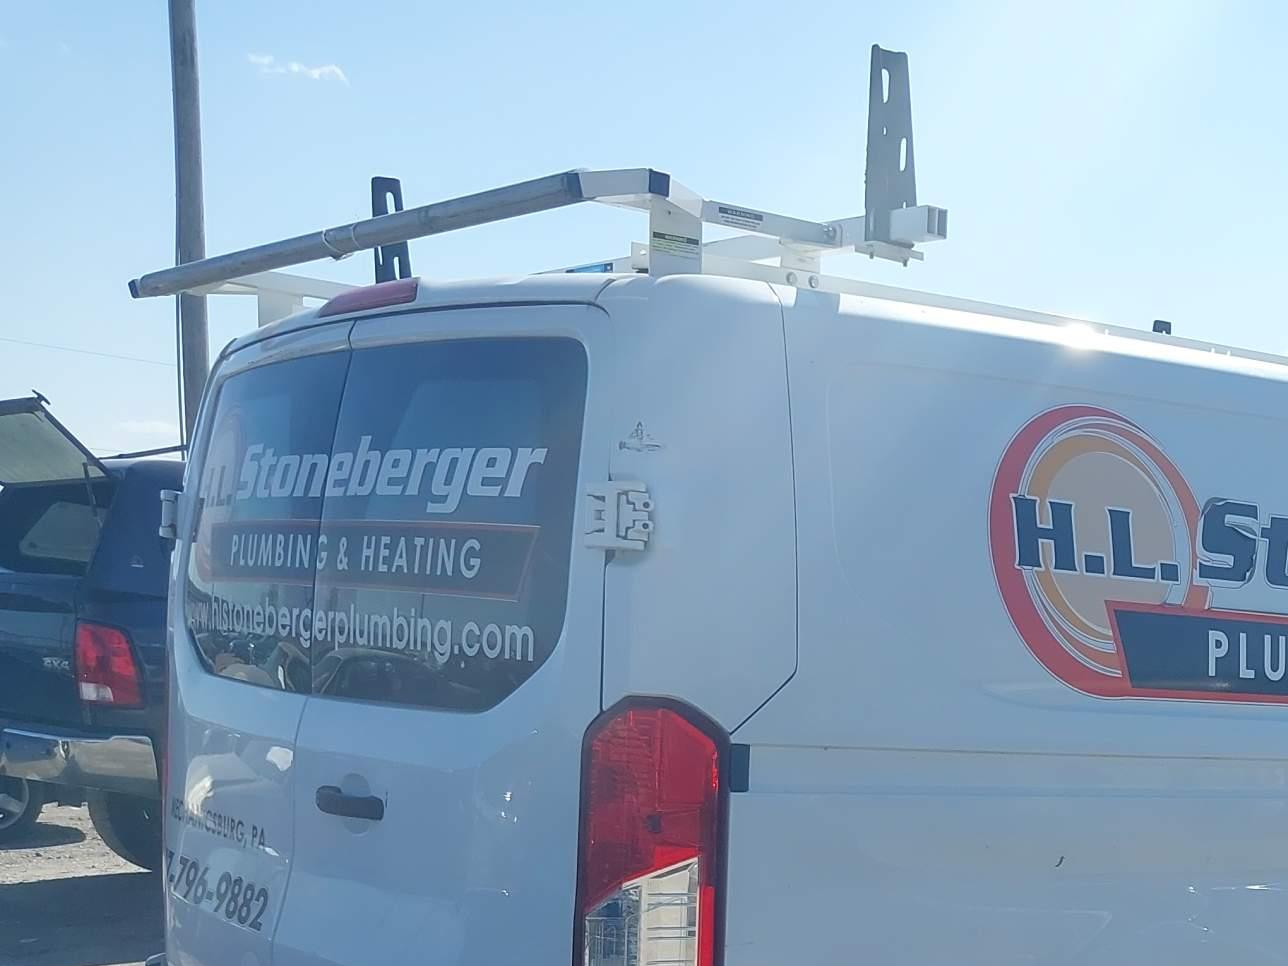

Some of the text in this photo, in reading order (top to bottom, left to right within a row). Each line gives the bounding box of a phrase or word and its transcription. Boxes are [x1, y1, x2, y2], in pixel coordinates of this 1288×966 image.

[234, 435, 548, 514] Stoneberger
[230, 533, 482, 580] PLUMBING & HEATING
[1011, 494, 1180, 584] H.L.
[251, 823, 266, 849] PA
